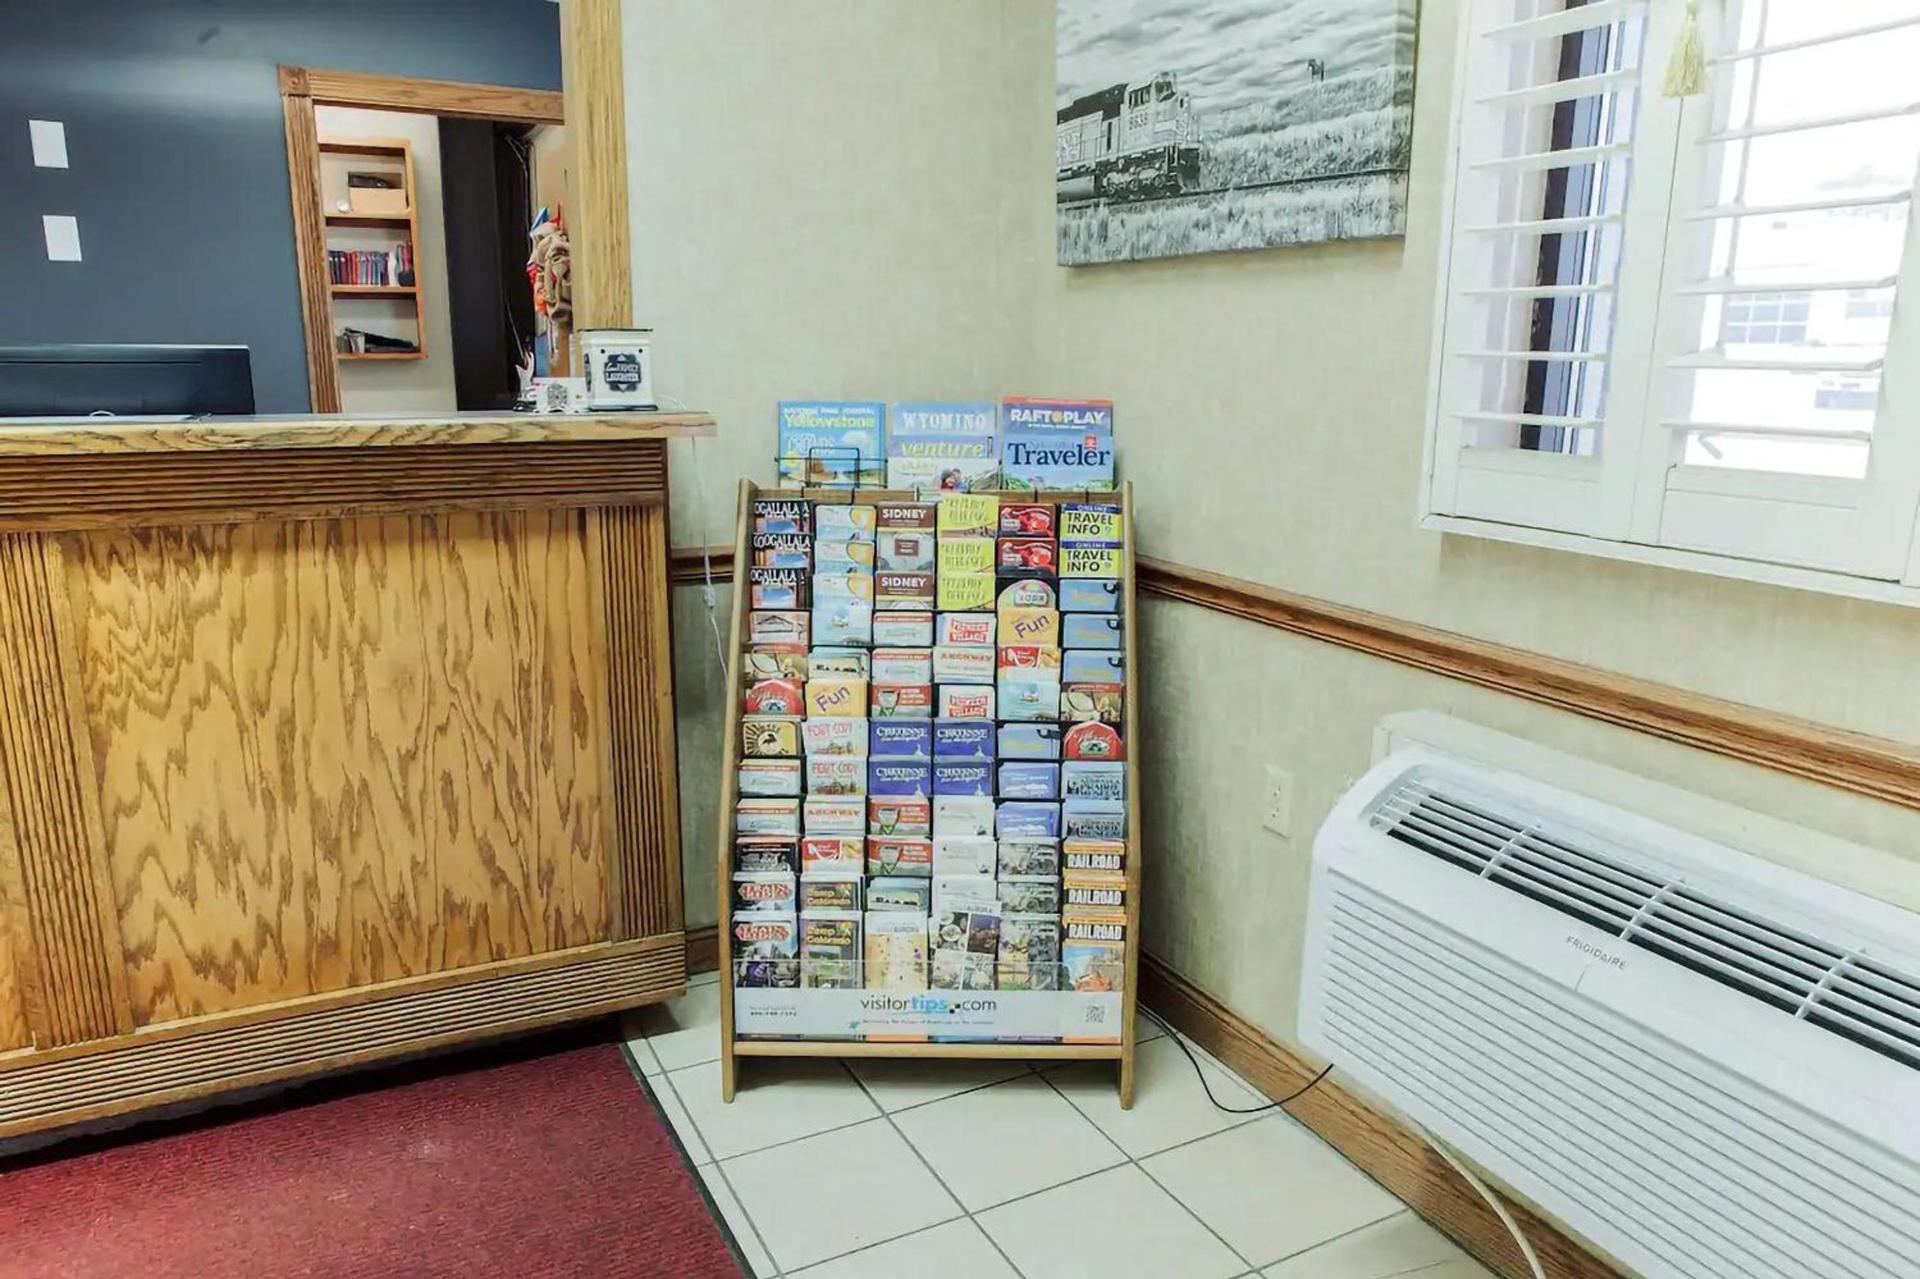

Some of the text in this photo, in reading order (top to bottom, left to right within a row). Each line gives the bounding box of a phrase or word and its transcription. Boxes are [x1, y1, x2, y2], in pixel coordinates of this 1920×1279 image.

[784, 413, 876, 429] Yellowstone
[1007, 442, 1111, 467] Traveler
[754, 502, 798, 515] OGALLALA
[882, 508, 926, 519] SIDNEY
[1066, 511, 1114, 526] TRAVEL
[1067, 523, 1100, 535] INFO
[1066, 549, 1113, 562] TRAVEL
[1066, 561, 1100, 573] INFO
[750, 569, 797, 582] OGALLALA
[881, 576, 927, 588] SIDNEY
[1014, 614, 1050, 639] Fun
[815, 685, 851, 712] Fun
[1066, 853, 1121, 869] RAILROAD
[1068, 889, 1122, 904] RAILROAD
[1068, 924, 1122, 940] RAILROAD
[1566, 935, 1627, 970] FRIGIDAIRE
